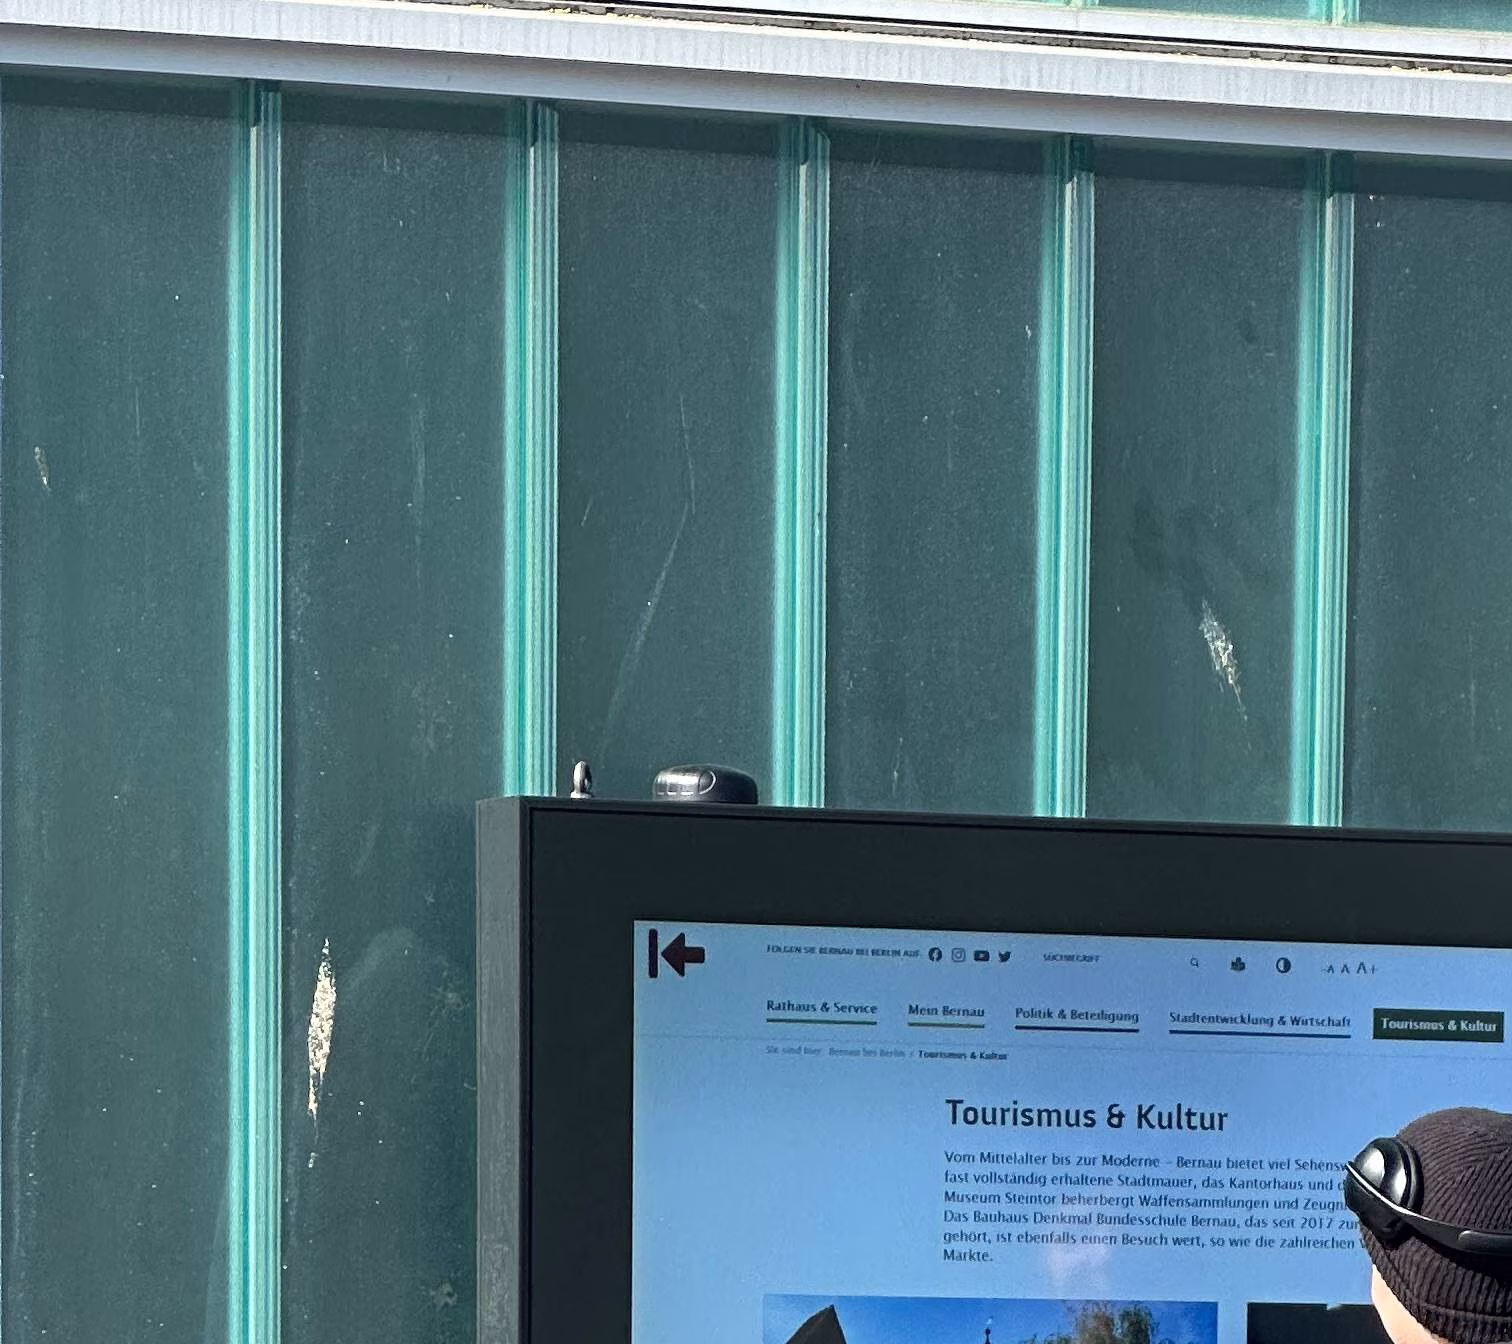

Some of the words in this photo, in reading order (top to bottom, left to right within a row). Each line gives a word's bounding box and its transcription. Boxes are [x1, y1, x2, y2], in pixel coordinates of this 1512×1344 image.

[766, 1000, 817, 1014] Rathaus
[820, 1001, 831, 1014] &
[833, 1002, 878, 1015] Service
[908, 1003, 939, 1017] Mein
[942, 1005, 986, 1018] Bernau
[1015, 1007, 1054, 1020] Politik
[1057, 1009, 1067, 1020] &
[1070, 1009, 1140, 1024] Beteiligung
[1169, 1011, 1274, 1028] Stadtentwicklung
[1277, 1015, 1287, 1026] &
[1290, 1015, 1351, 1028] Wirtschaft
[1380, 1017, 1445, 1031] Tourismus
[1447, 1019, 1457, 1031] &
[1459, 1019, 1498, 1033] Kultur
[945, 1098, 1097, 1129] Tourismus
[1106, 1103, 1126, 1129] &
[1137, 1103, 1230, 1132] Kultur
[944, 1150, 976, 1165] Vom
[980, 1151, 1048, 1166] Mittelalter
[1051, 1153, 1072, 1167] bis
[1075, 1156, 1098, 1168] zur
[1102, 1154, 1161, 1169] Moderne
[1176, 1156, 1222, 1170] Bernau
[1226, 1156, 1264, 1171] bietet
[1268, 1157, 1291, 1171] viel
[944, 1169, 969, 1184] fast
[1051, 1173, 1114, 1187] erhaltene
[1117, 1174, 1197, 1190] Stadtmauer,
[1201, 1176, 1226, 1189] das
[1229, 1177, 1303, 1190] Kantorhaus
[1308, 1179, 1334, 1191] und
[943, 1190, 1001, 1204] Museum
[1005, 1191, 1057, 1205] Steintor
[1061, 1193, 1135, 1208] beherbergt
[1139, 1194, 1269, 1211] Waffensammlungen
[1274, 1197, 1299, 1210] und
[943, 1209, 969, 1223] Das
[973, 1210, 1029, 1225] Bauhaus
[1033, 1212, 1093, 1225] Denkmal
[1097, 1213, 1187, 1227] Bundesschule
[1191, 1214, 1241, 1229] Bernau,
[1244, 1215, 1269, 1229] das
[1272, 1217, 1296, 1229] seit
[1300, 1216, 1334, 1230] 2017
[996, 1231, 1012, 1244] ist
[1016, 1231, 1077, 1245] ebenfalls
[1081, 1233, 1117, 1245] einen
[1121, 1232, 1168, 1246] Besuch
[1171, 1234, 1205, 1249] wert,
[1209, 1237, 1225, 1248] so
[1229, 1235, 1251, 1248] wie
[1254, 1235, 1276, 1249] die
[1280, 1235, 1355, 1250] zahlreichen
